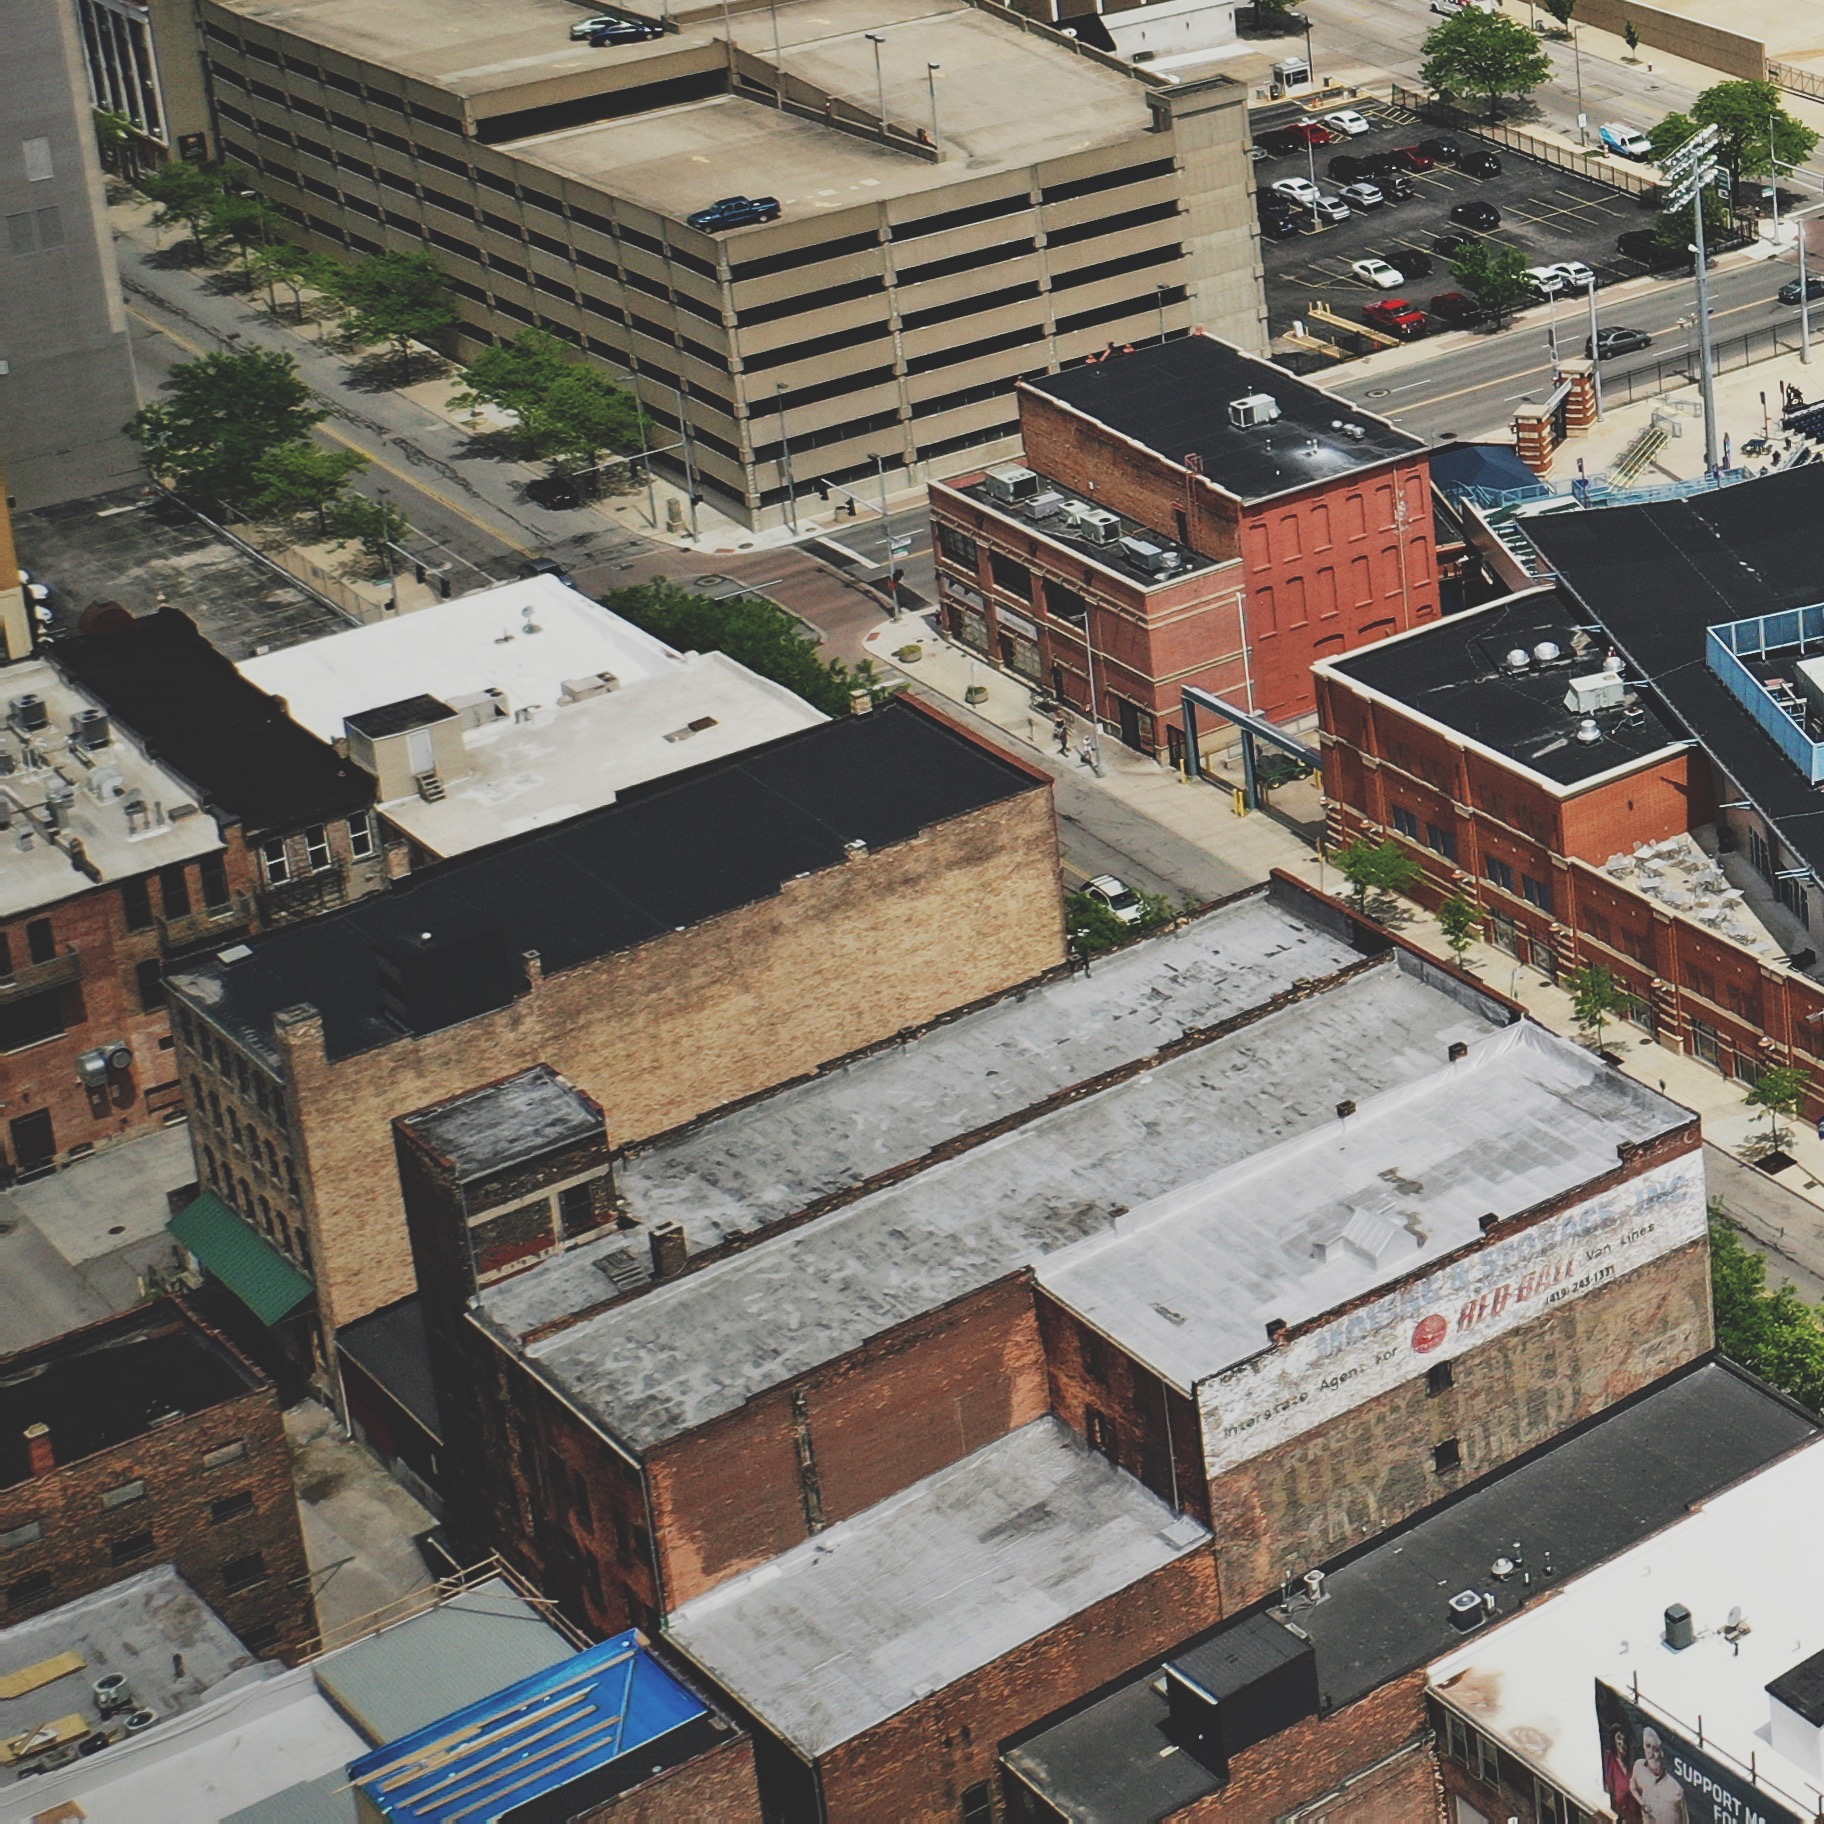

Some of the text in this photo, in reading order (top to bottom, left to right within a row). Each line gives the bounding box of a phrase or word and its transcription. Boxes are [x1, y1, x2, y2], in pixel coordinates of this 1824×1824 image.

[1585, 1242, 1612, 1263] Van
[1620, 1223, 1655, 1247] Lines
[1223, 1392, 1309, 1438] Interstate
[1319, 1363, 1366, 1392] Agent
[1673, 1757, 1742, 1816] SUPPORT
